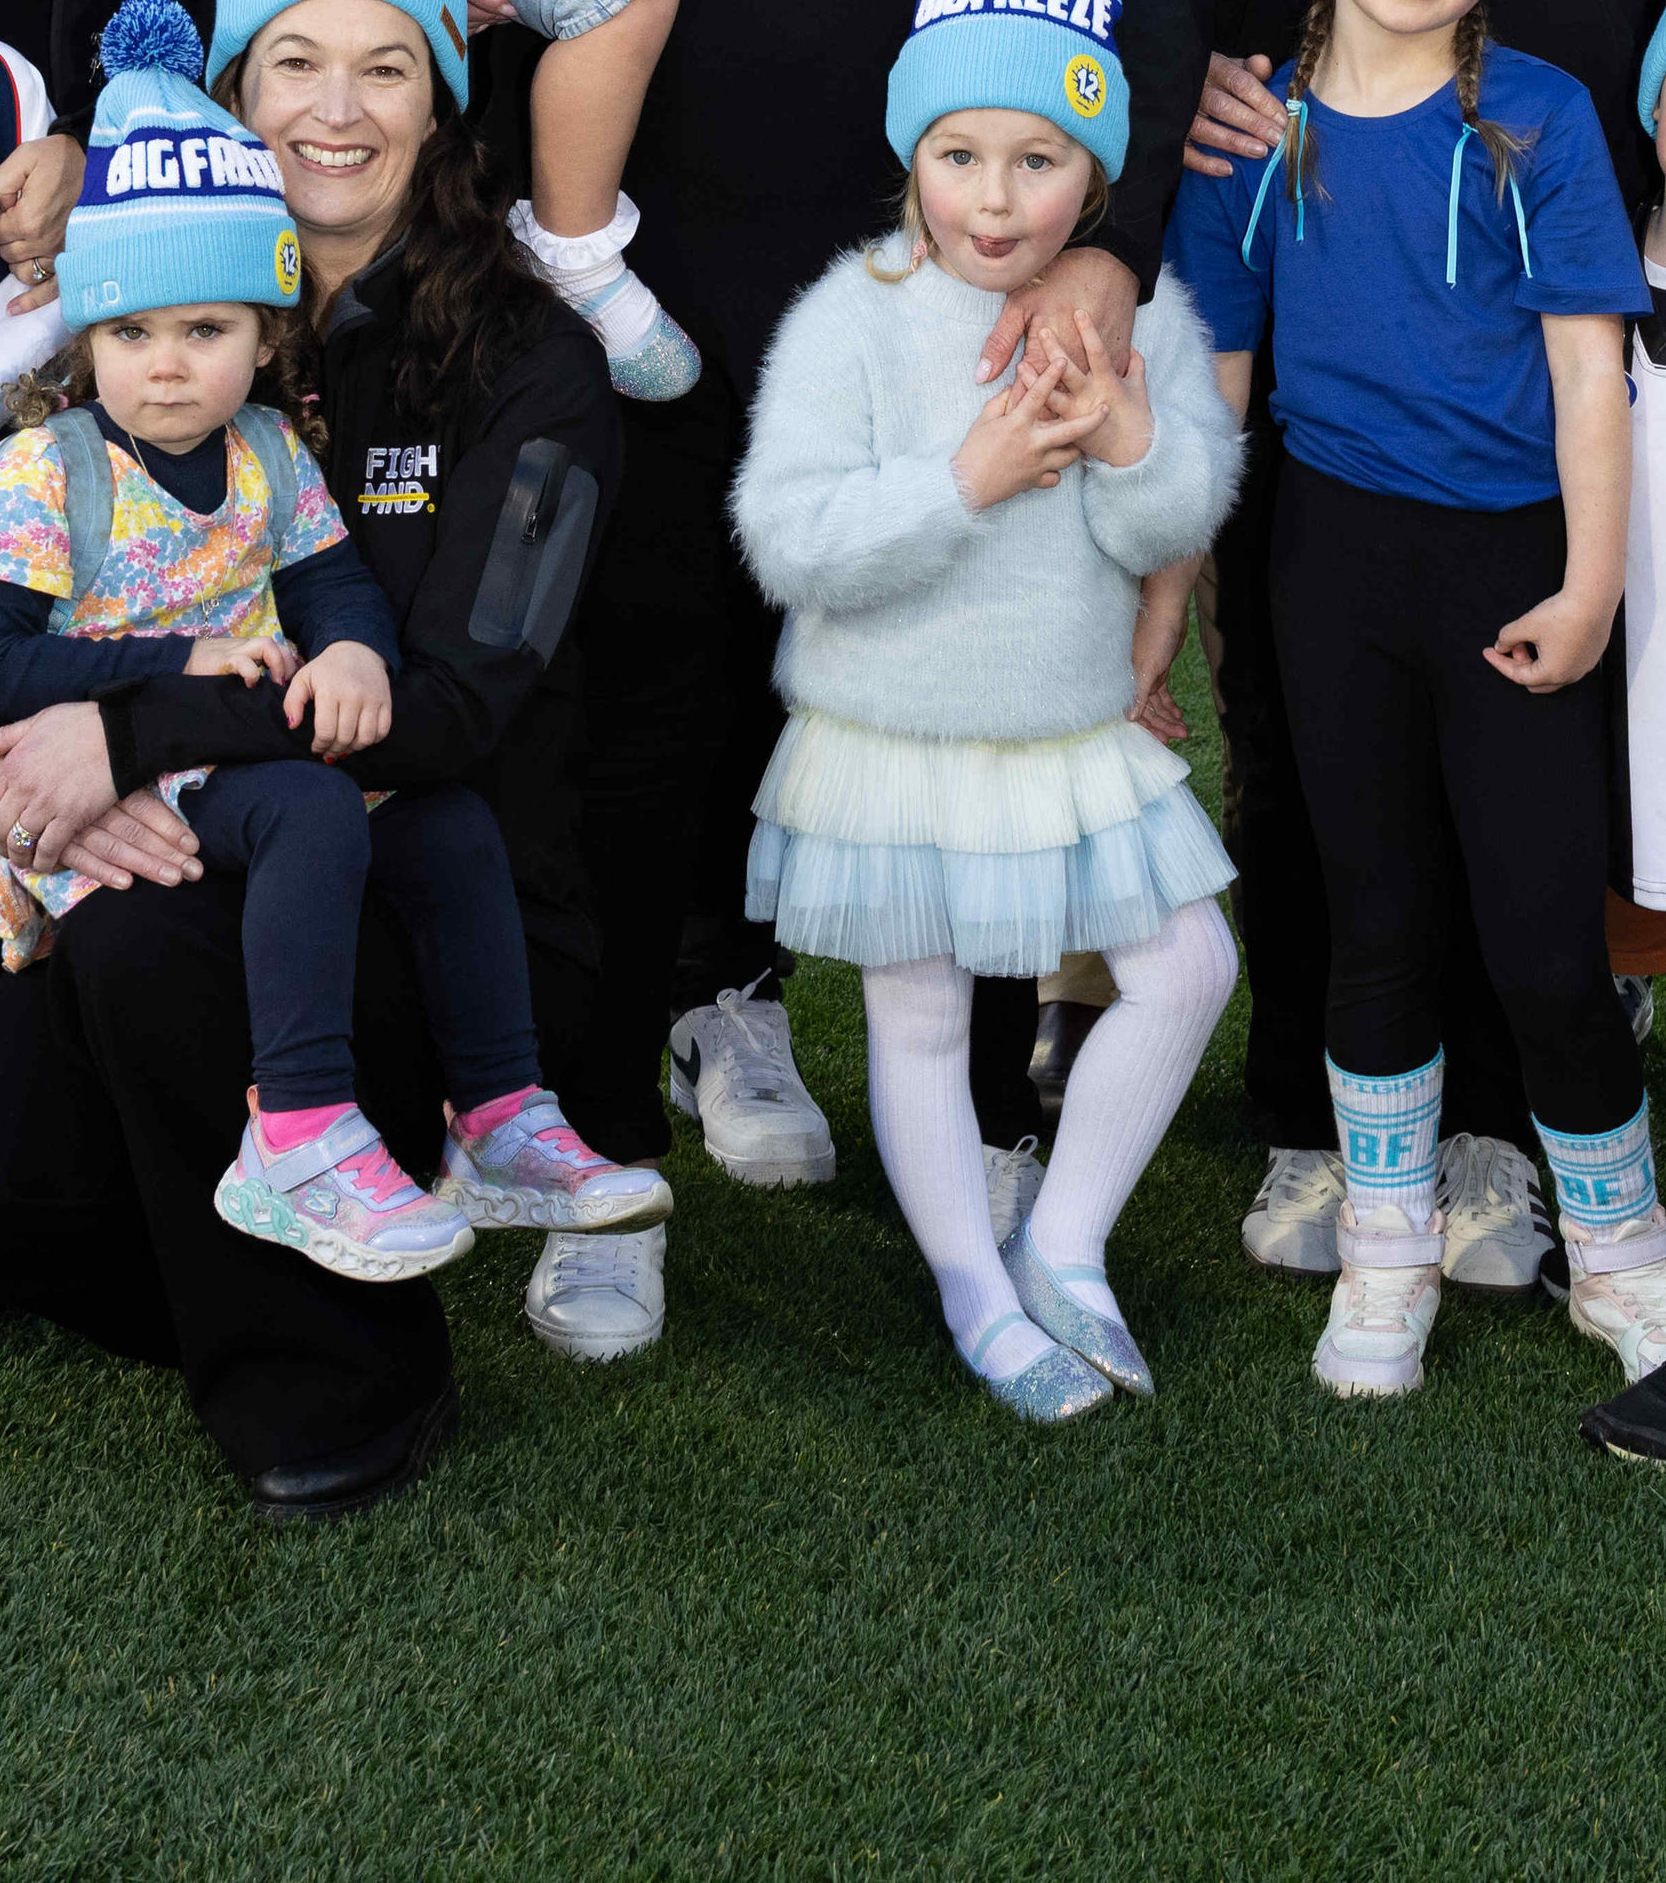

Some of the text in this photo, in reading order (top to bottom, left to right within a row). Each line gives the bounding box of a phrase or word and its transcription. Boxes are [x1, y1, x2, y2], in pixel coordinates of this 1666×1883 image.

[1077, 68, 1099, 102] 12
[106, 138, 180, 196] BIG
[283, 245, 296, 276] 12
[366, 445, 440, 479] FIGH
[1342, 1075, 1426, 1094] FIGHT
[1348, 1128, 1416, 1168] BF
